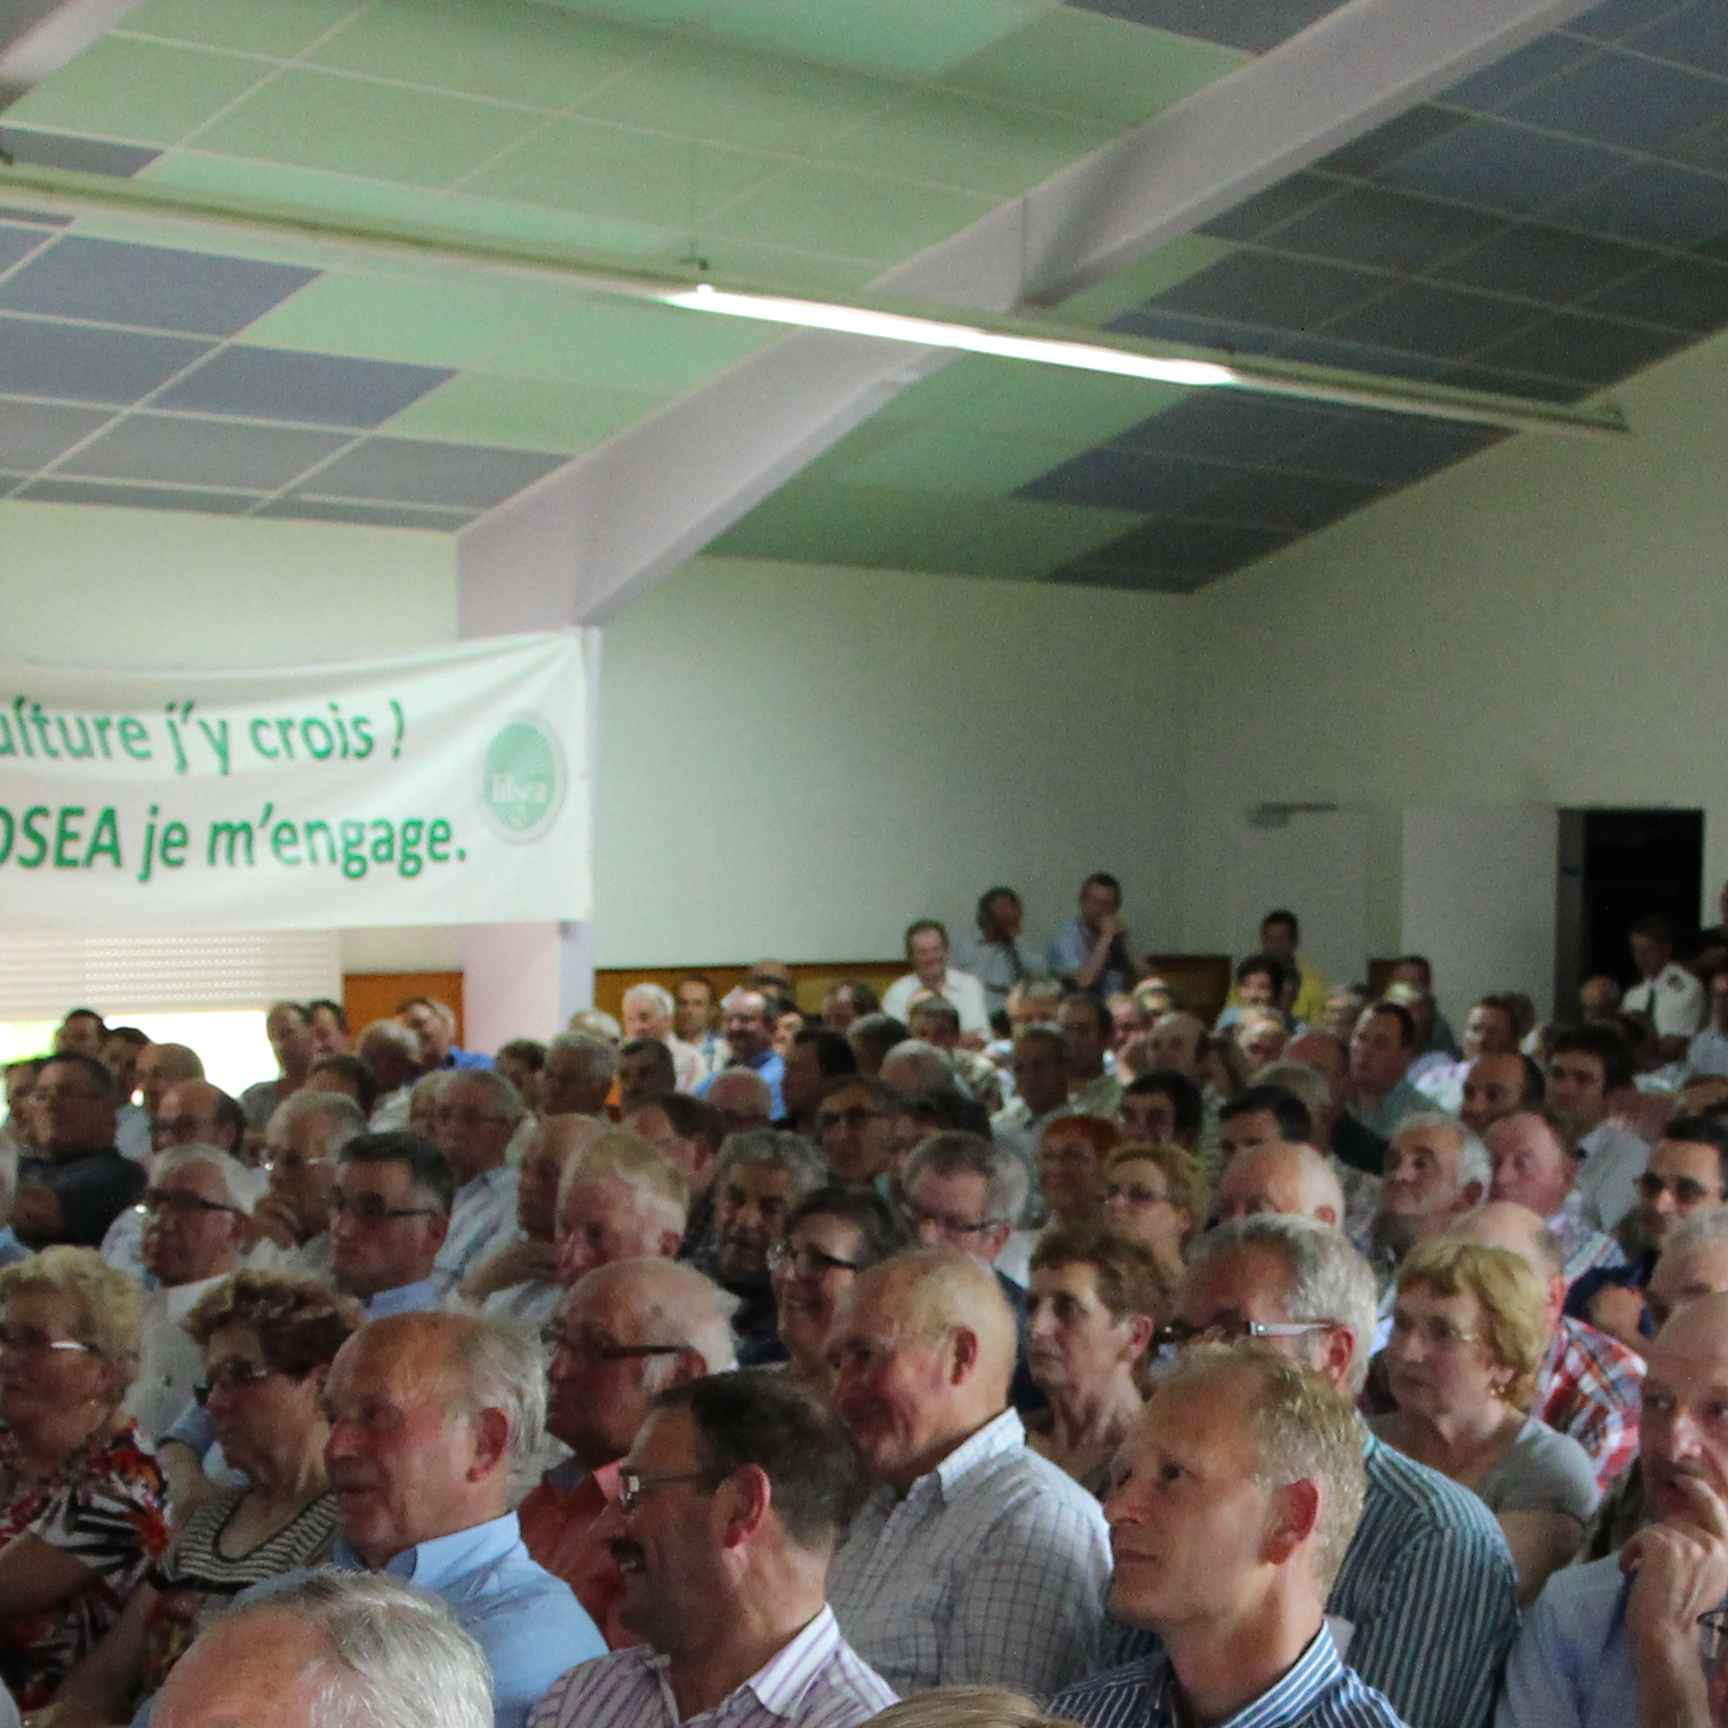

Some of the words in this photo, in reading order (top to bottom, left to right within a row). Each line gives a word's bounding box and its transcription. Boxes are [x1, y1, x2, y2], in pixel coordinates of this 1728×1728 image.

[248, 700, 376, 760] crois
[385, 697, 406, 759] !
[134, 802, 189, 883] je
[207, 800, 468, 880] m'engage.
